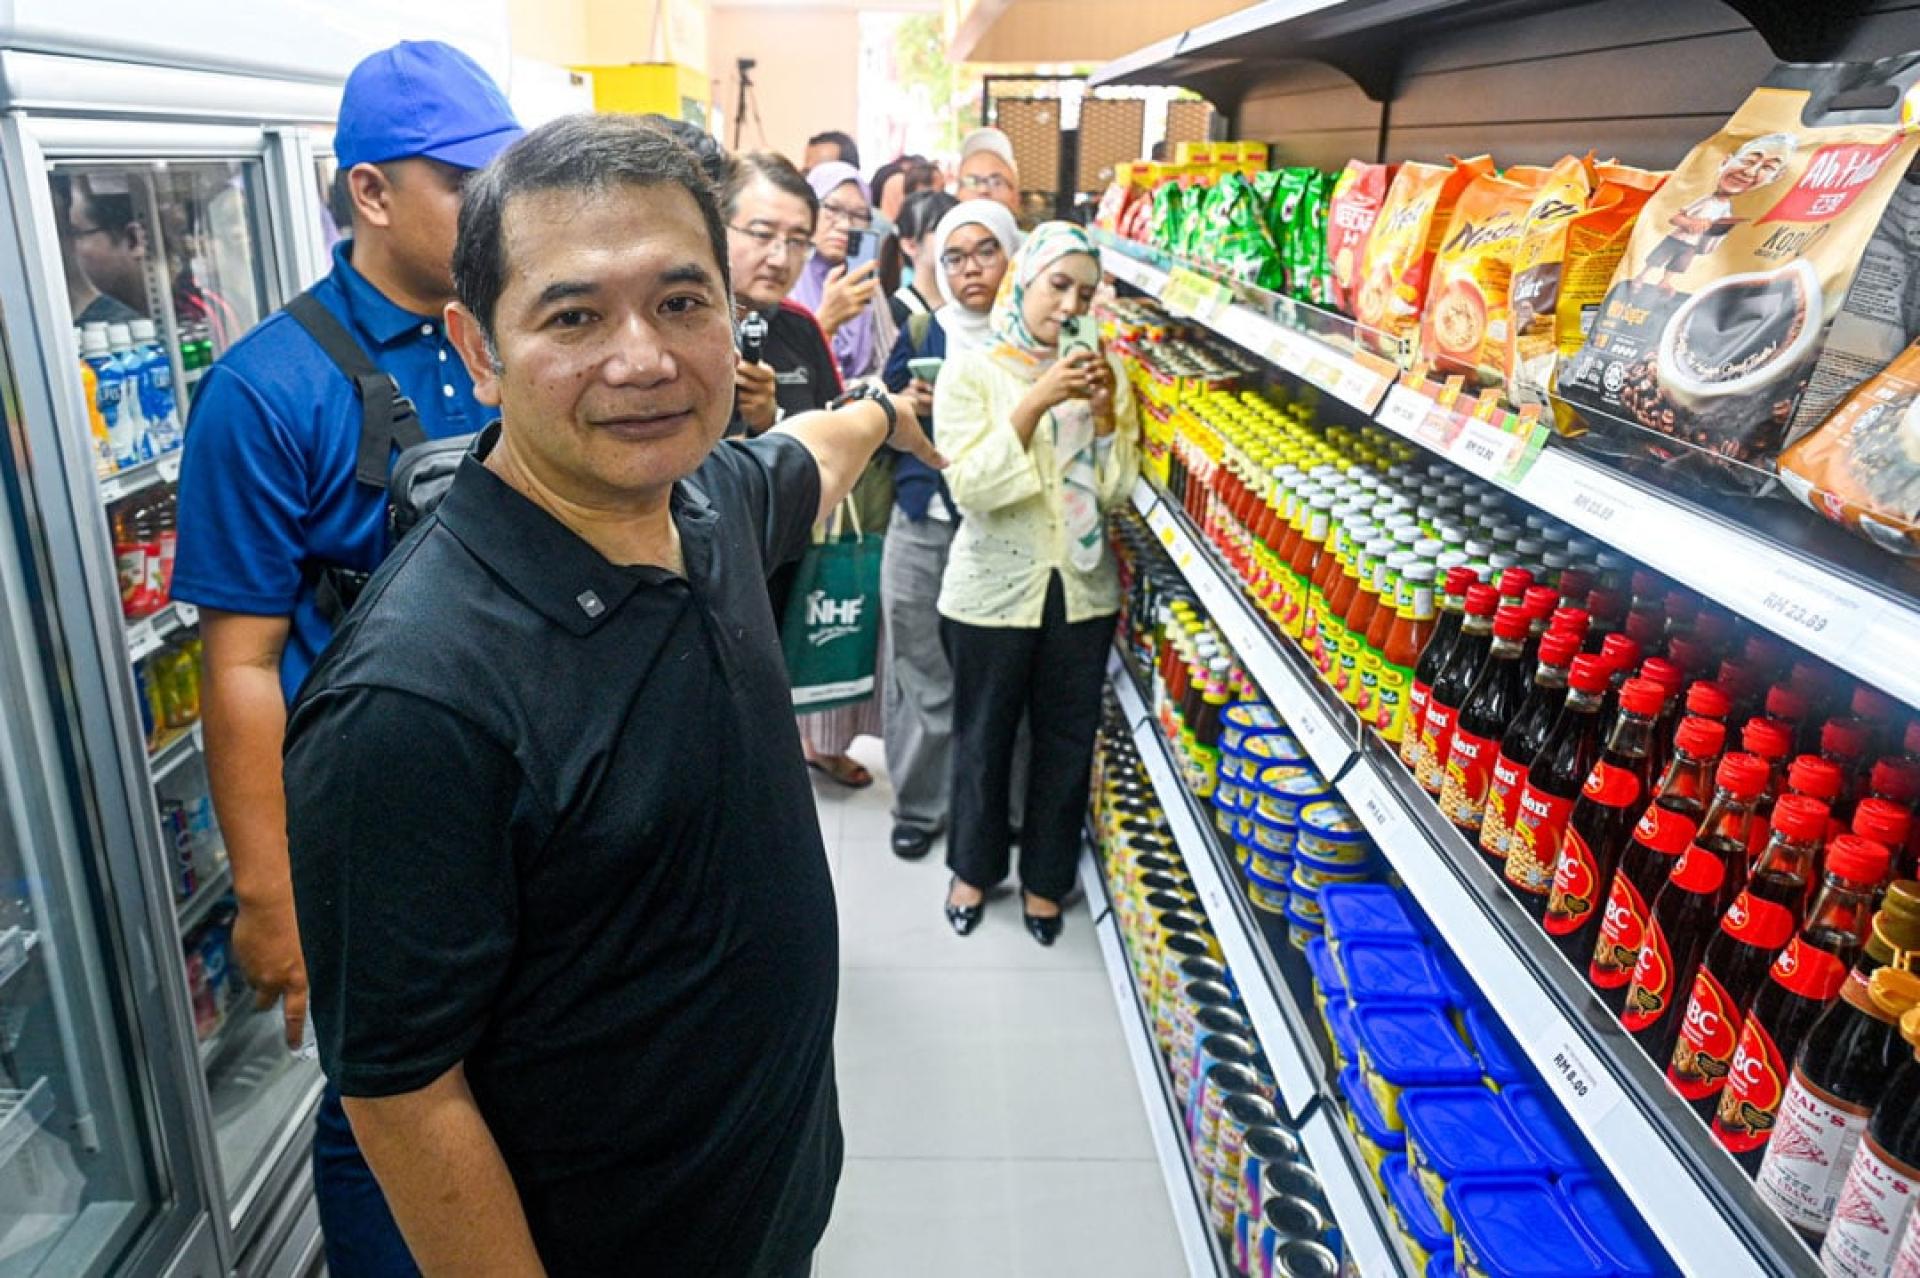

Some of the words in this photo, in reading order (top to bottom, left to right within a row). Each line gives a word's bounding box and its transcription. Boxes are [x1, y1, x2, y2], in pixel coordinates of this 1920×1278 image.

[806, 590, 865, 625] NHF
[1606, 895, 1631, 929] BC
[1686, 998, 1718, 1037] BC
[1553, 1052, 1571, 1074] RM
[1566, 1070, 1588, 1097] 8.00
[1732, 1043, 1763, 1084] BC
